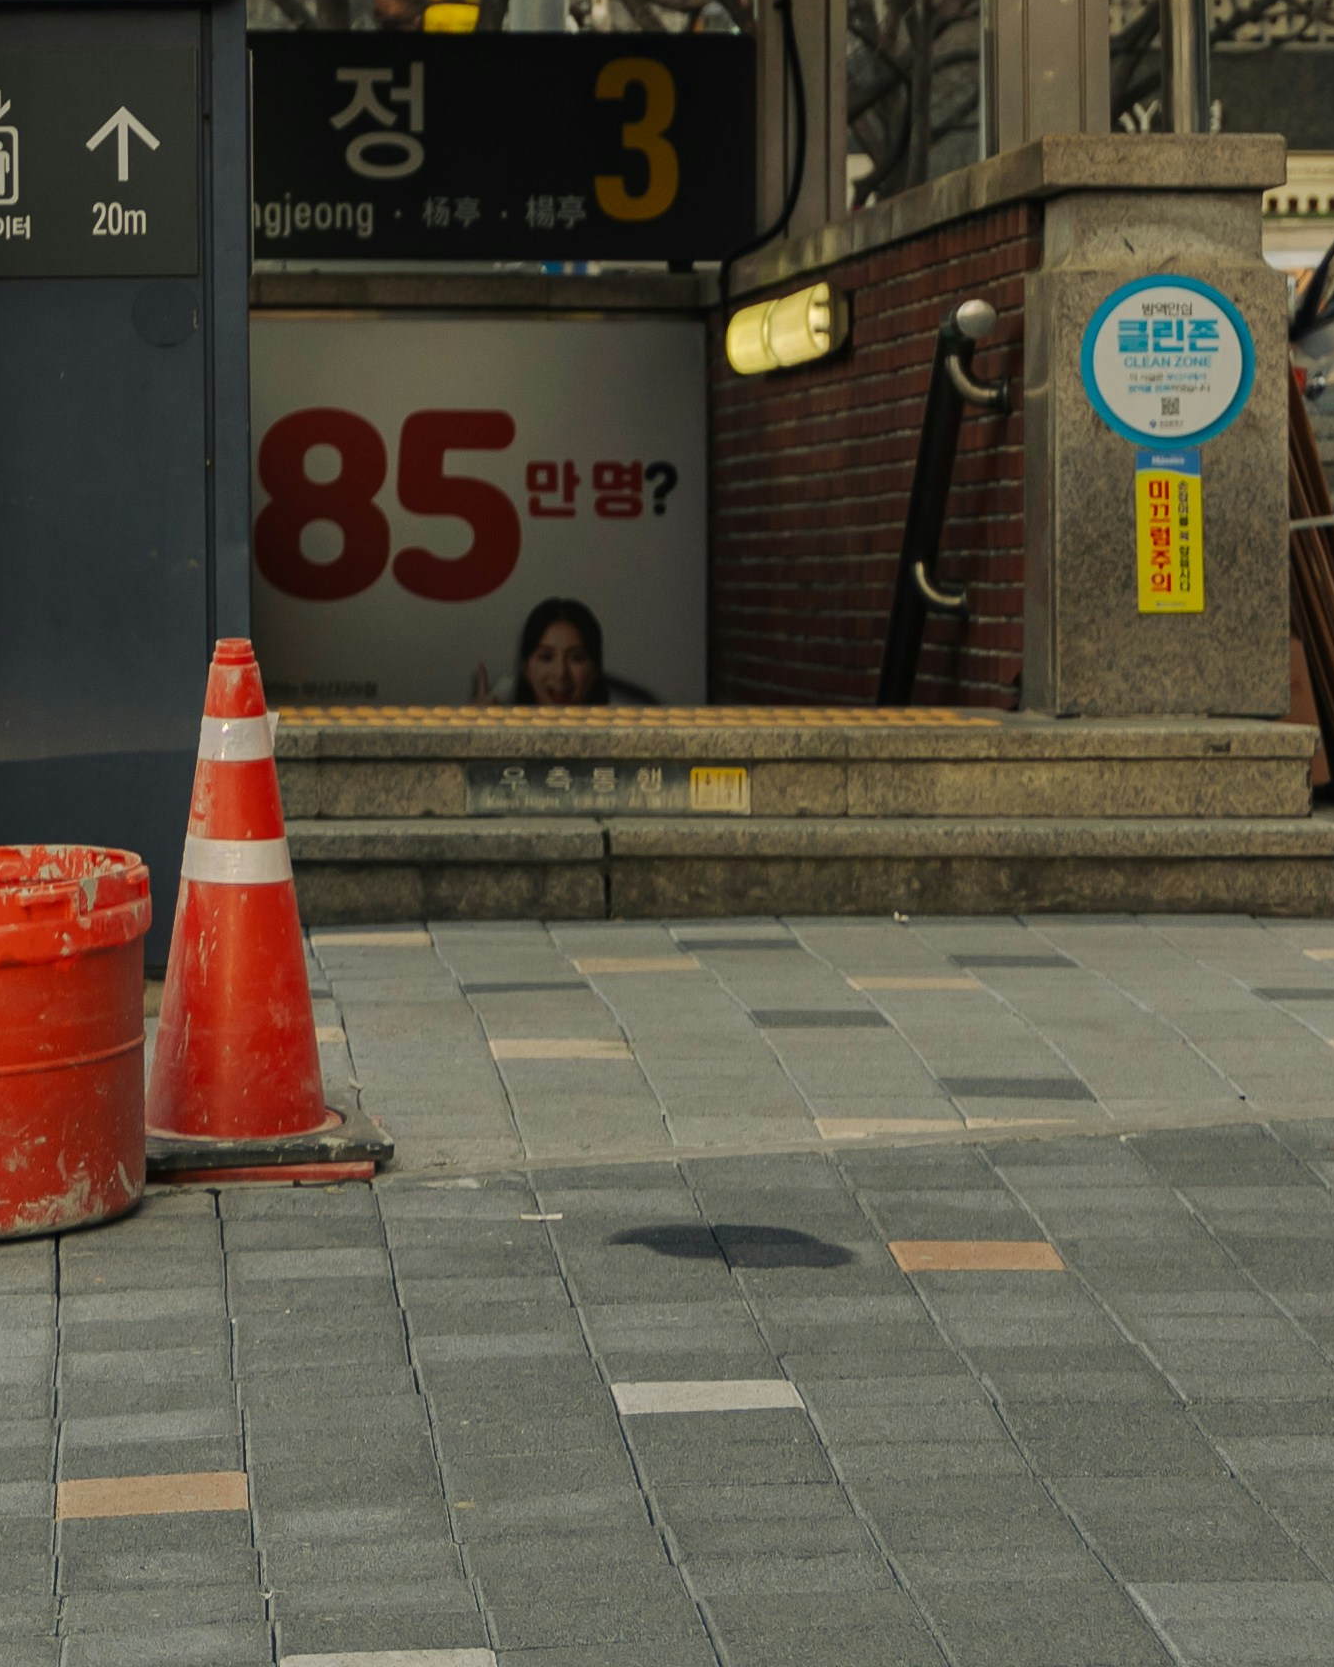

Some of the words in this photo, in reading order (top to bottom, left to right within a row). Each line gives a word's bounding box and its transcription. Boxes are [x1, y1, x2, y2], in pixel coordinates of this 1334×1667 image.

[329, 61, 426, 180] 정
[593, 56, 681, 223] 3
[92, 201, 147, 236] 20m
[1117, 319, 1220, 354] 클린존
[1124, 355, 1171, 368] CLEAN
[1174, 355, 1213, 368] ZONE
